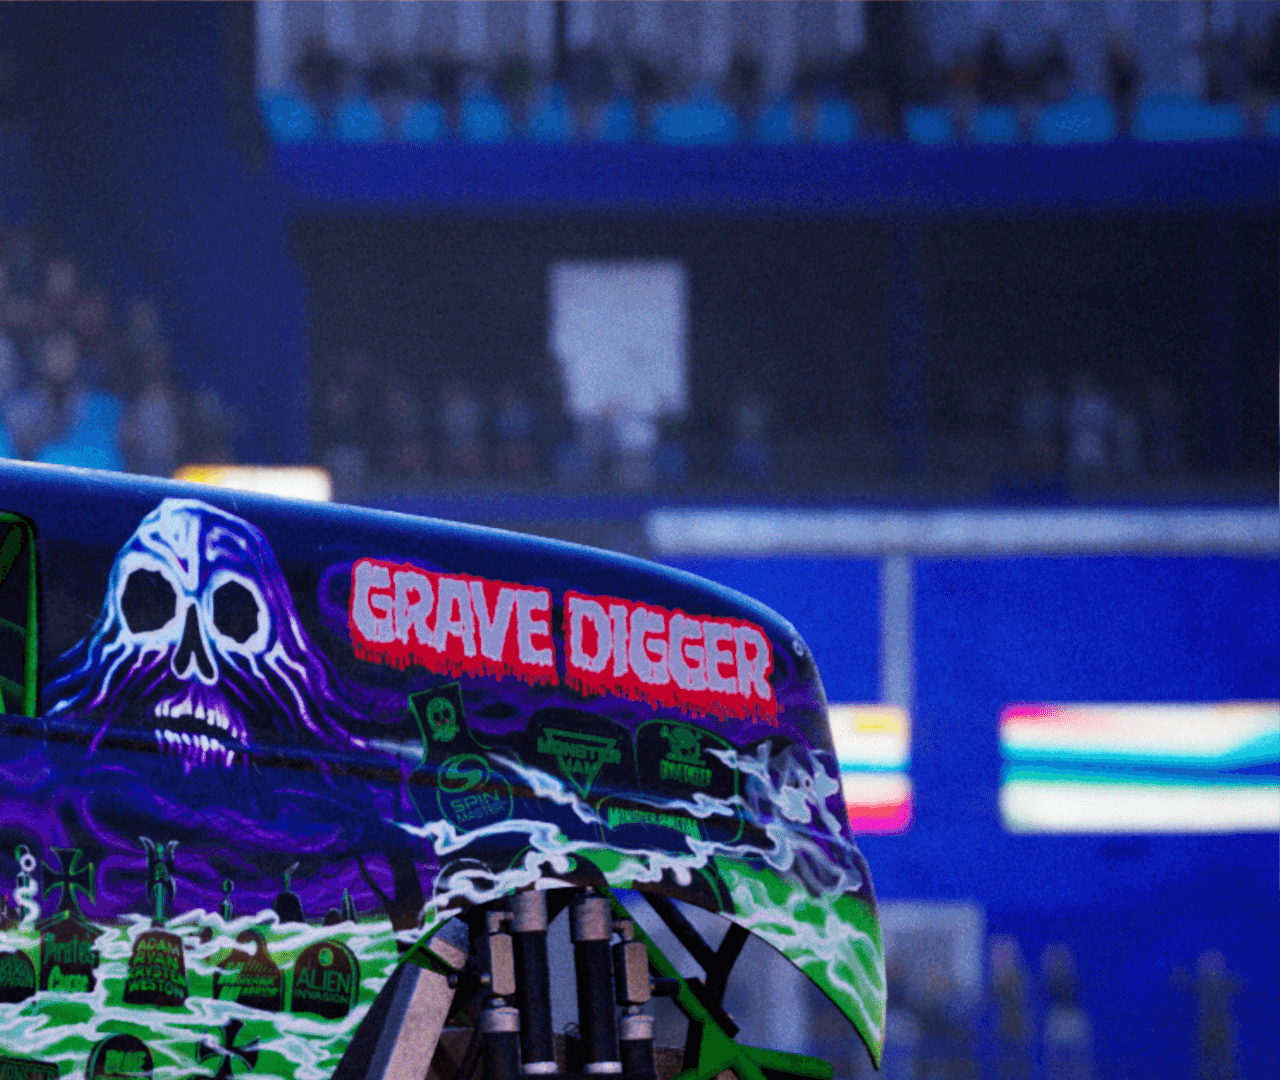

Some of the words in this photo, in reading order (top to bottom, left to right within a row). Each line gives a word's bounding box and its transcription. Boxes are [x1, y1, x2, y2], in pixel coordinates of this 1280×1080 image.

[351, 558, 555, 680] GRAVE
[564, 593, 777, 714] DIGGER
[536, 736, 622, 765] MONSTER
[450, 789, 501, 814] SPIN
[136, 938, 181, 955] ADAM
[132, 951, 180, 971] RYAN
[127, 979, 186, 999] WESTON
[295, 966, 351, 994] ALIEN
